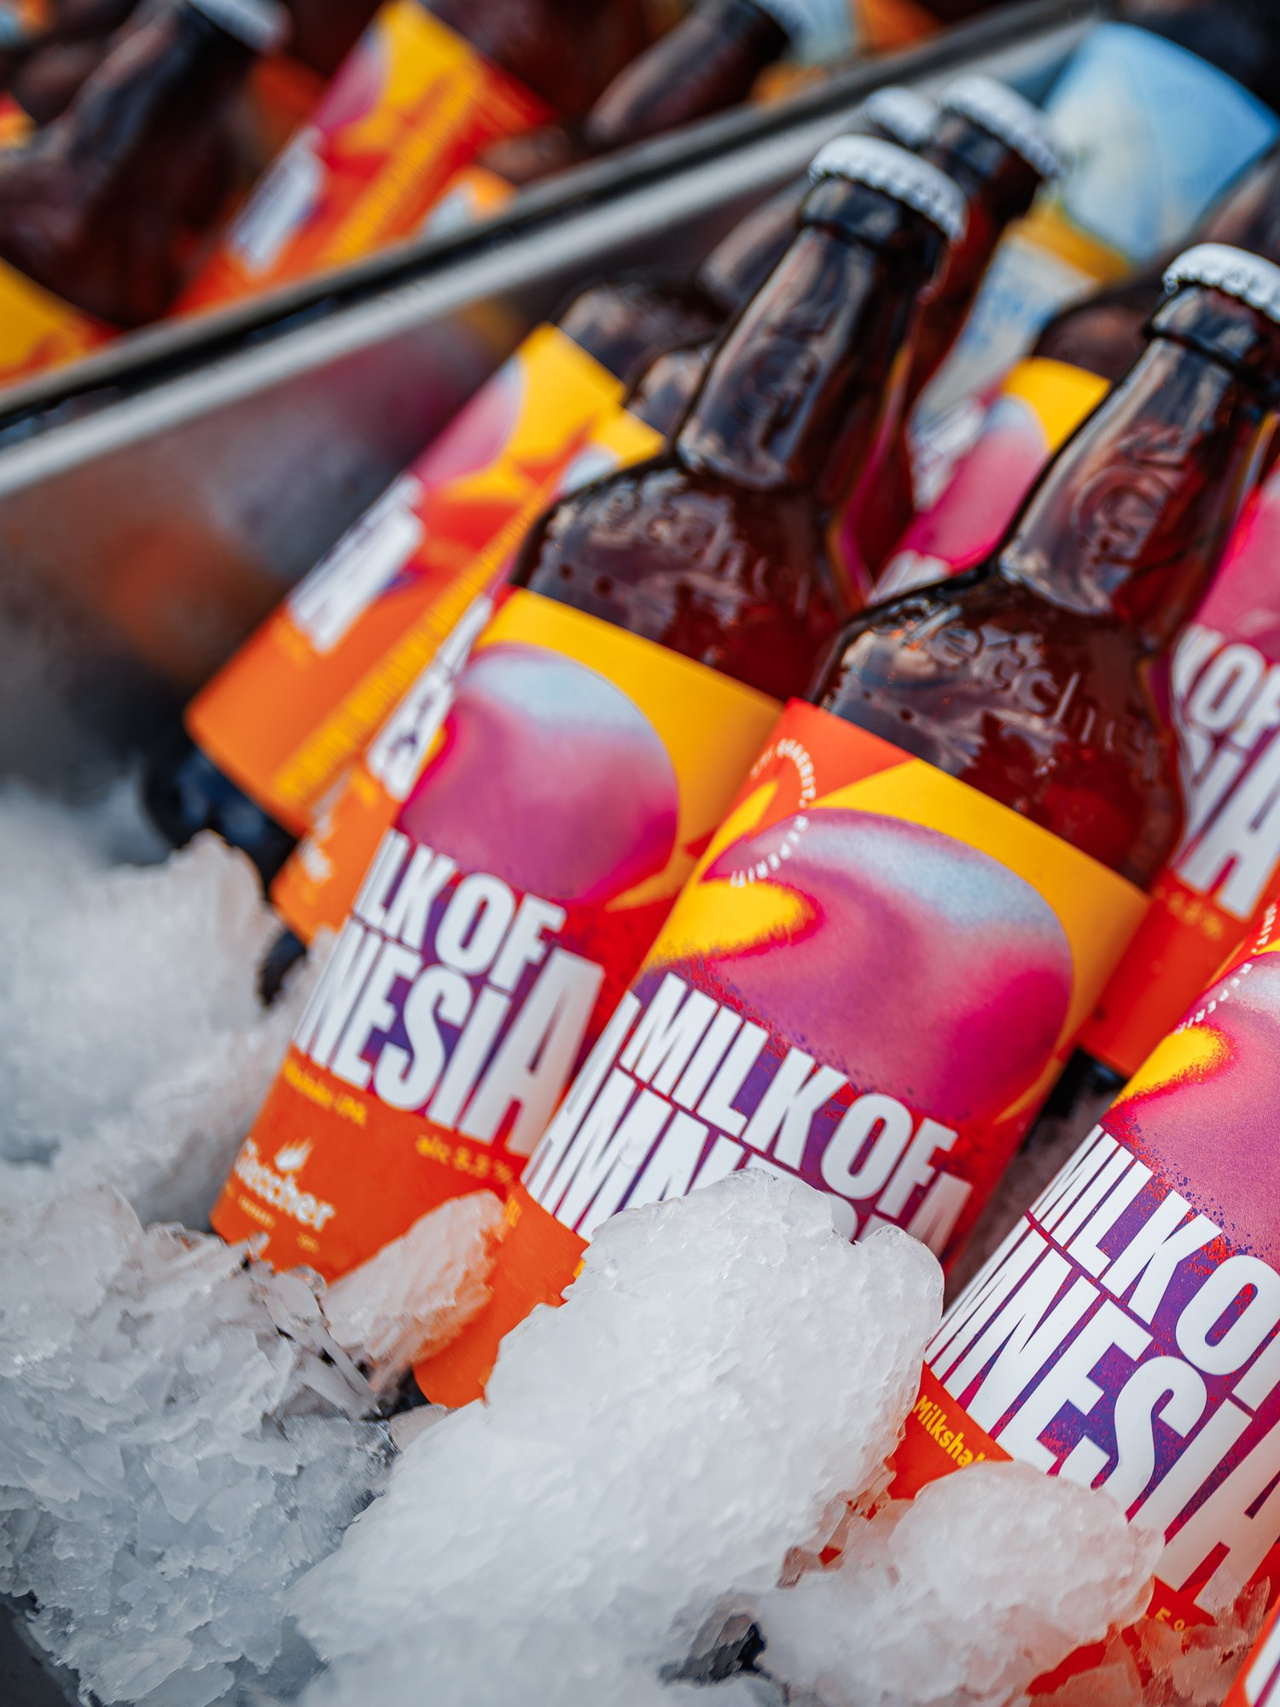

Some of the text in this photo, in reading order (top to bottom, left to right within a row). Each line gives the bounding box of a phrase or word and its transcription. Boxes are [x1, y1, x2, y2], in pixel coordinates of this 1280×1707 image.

[435, 873, 566, 991] OF
[618, 971, 959, 1219] MILK OF
[1028, 1124, 1222, 1326] MILK
[912, 1394, 986, 1468] Milksha
